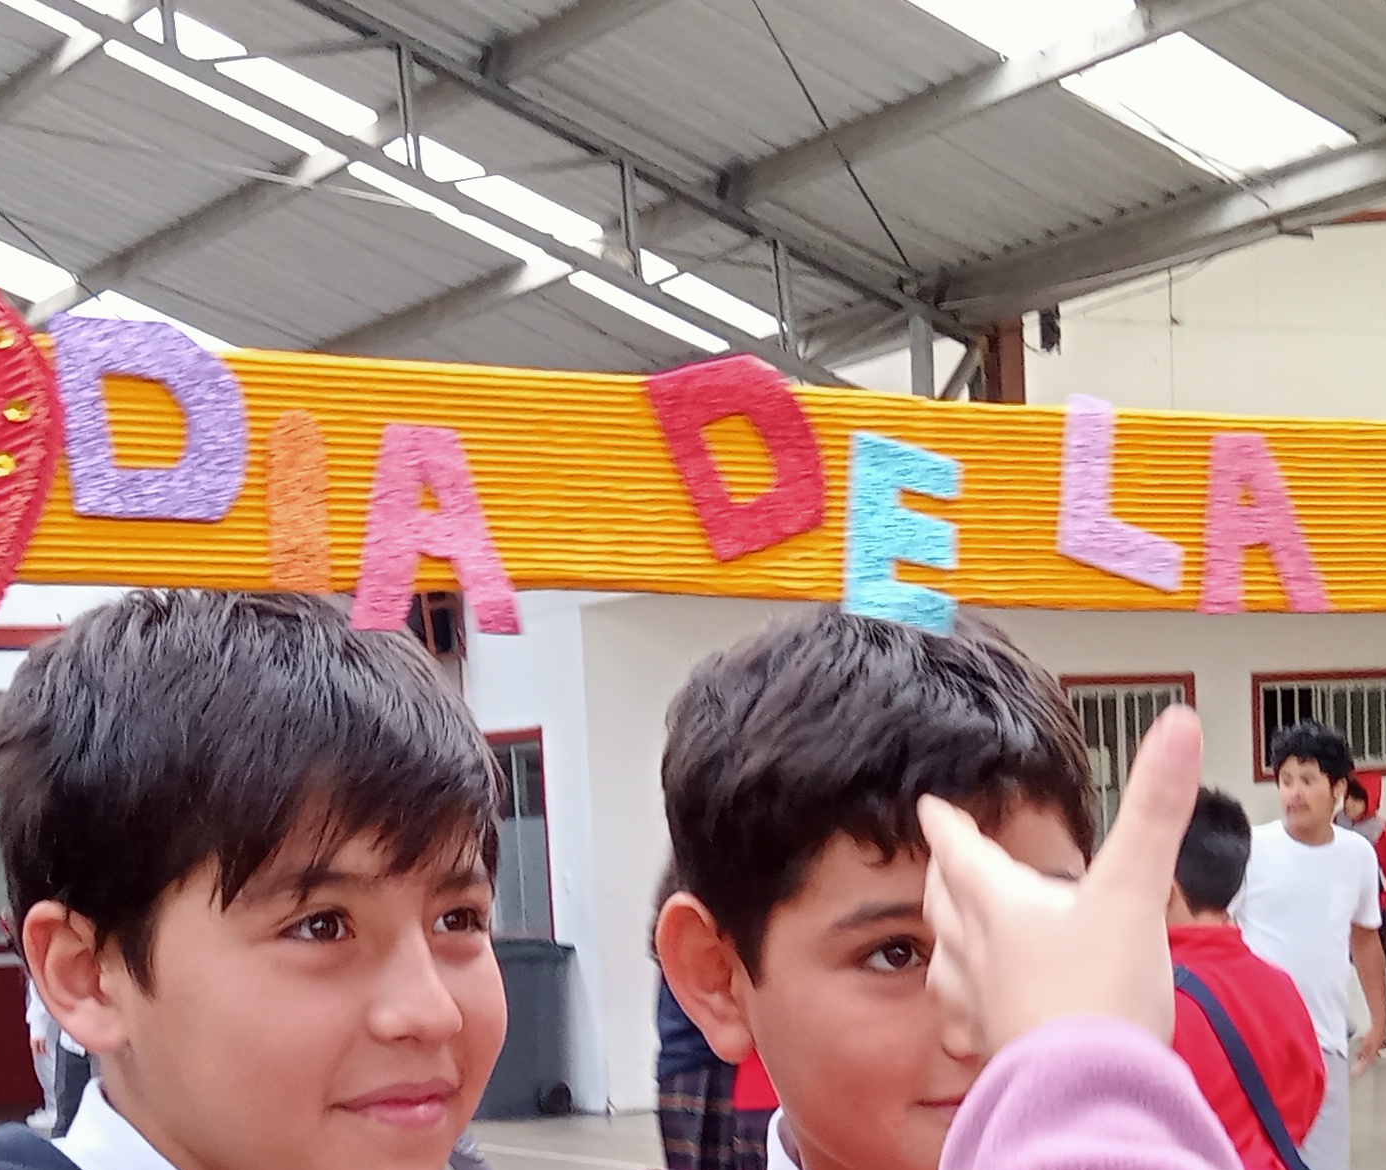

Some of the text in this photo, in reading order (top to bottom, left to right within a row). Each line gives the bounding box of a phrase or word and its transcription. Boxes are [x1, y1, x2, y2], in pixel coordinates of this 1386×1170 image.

[48, 311, 1335, 638] DIA DE LA
